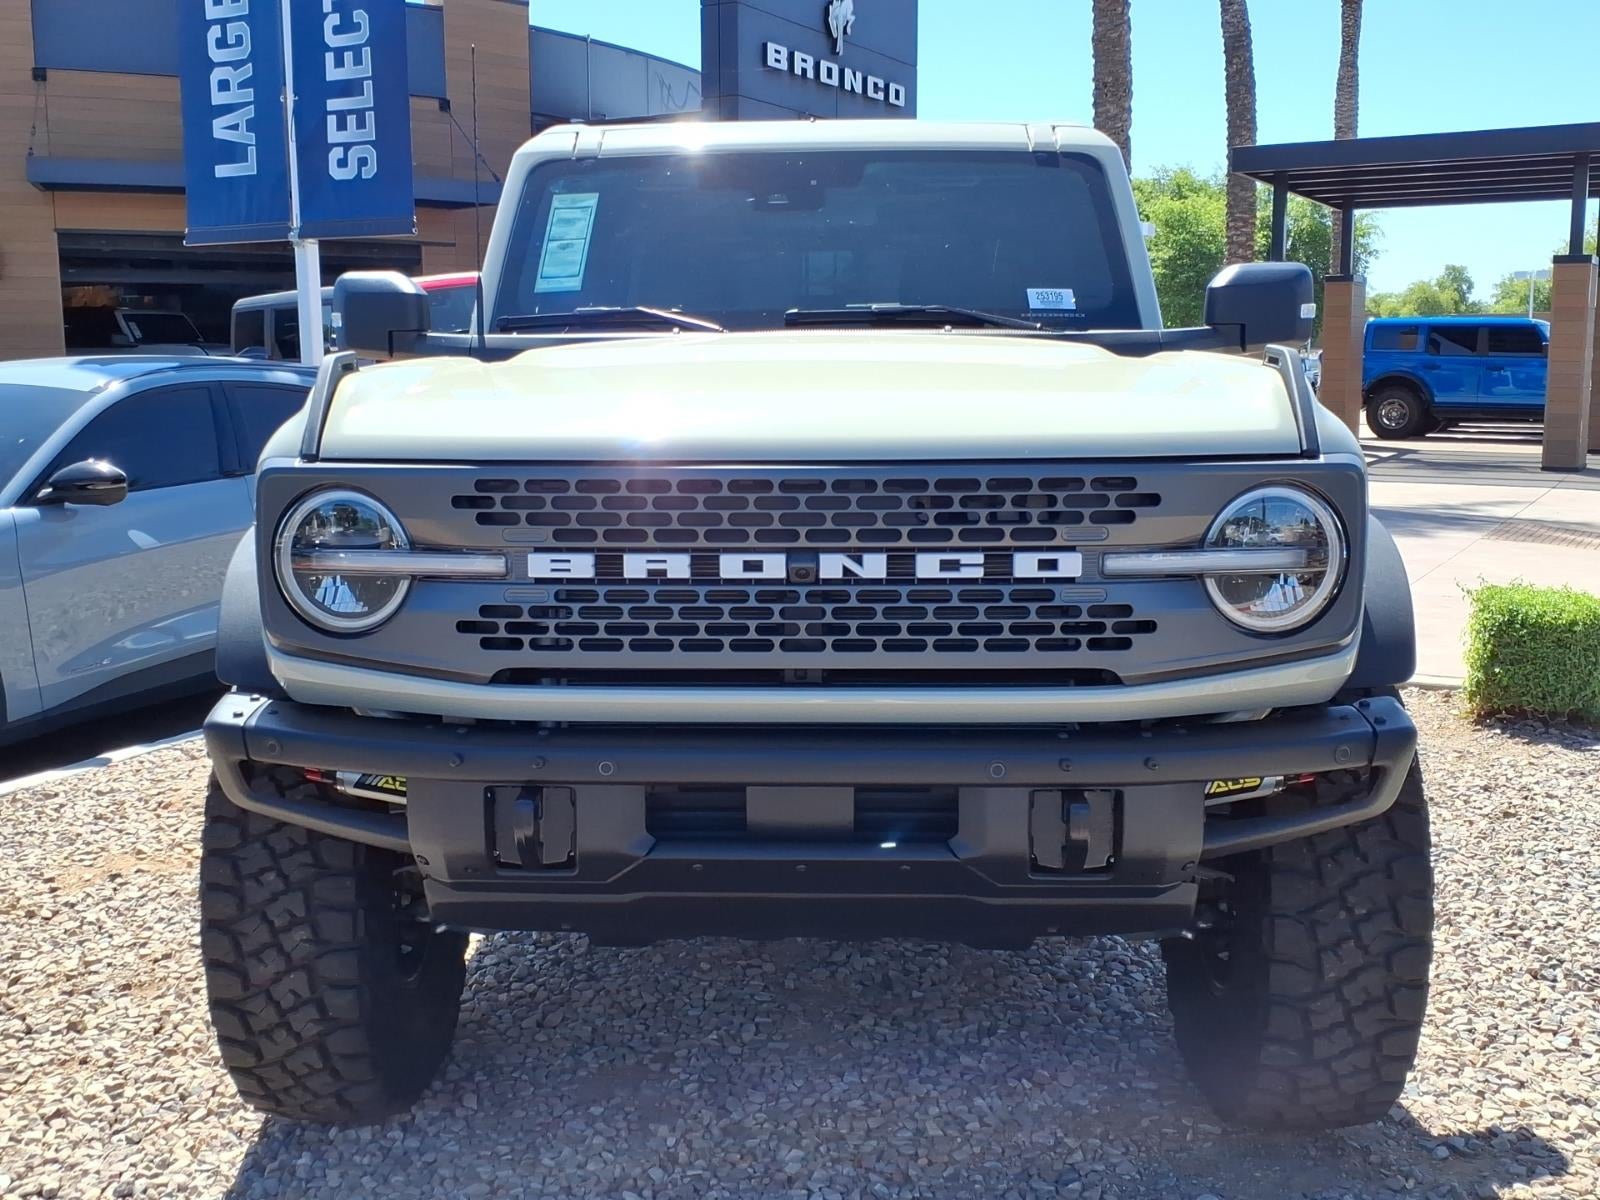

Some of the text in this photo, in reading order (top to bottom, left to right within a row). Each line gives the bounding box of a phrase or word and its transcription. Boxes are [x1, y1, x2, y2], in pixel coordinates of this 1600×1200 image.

[204, 0, 257, 178] LARGE
[766, 41, 905, 107] BRONCO
[527, 552, 1083, 579] BRONCO
